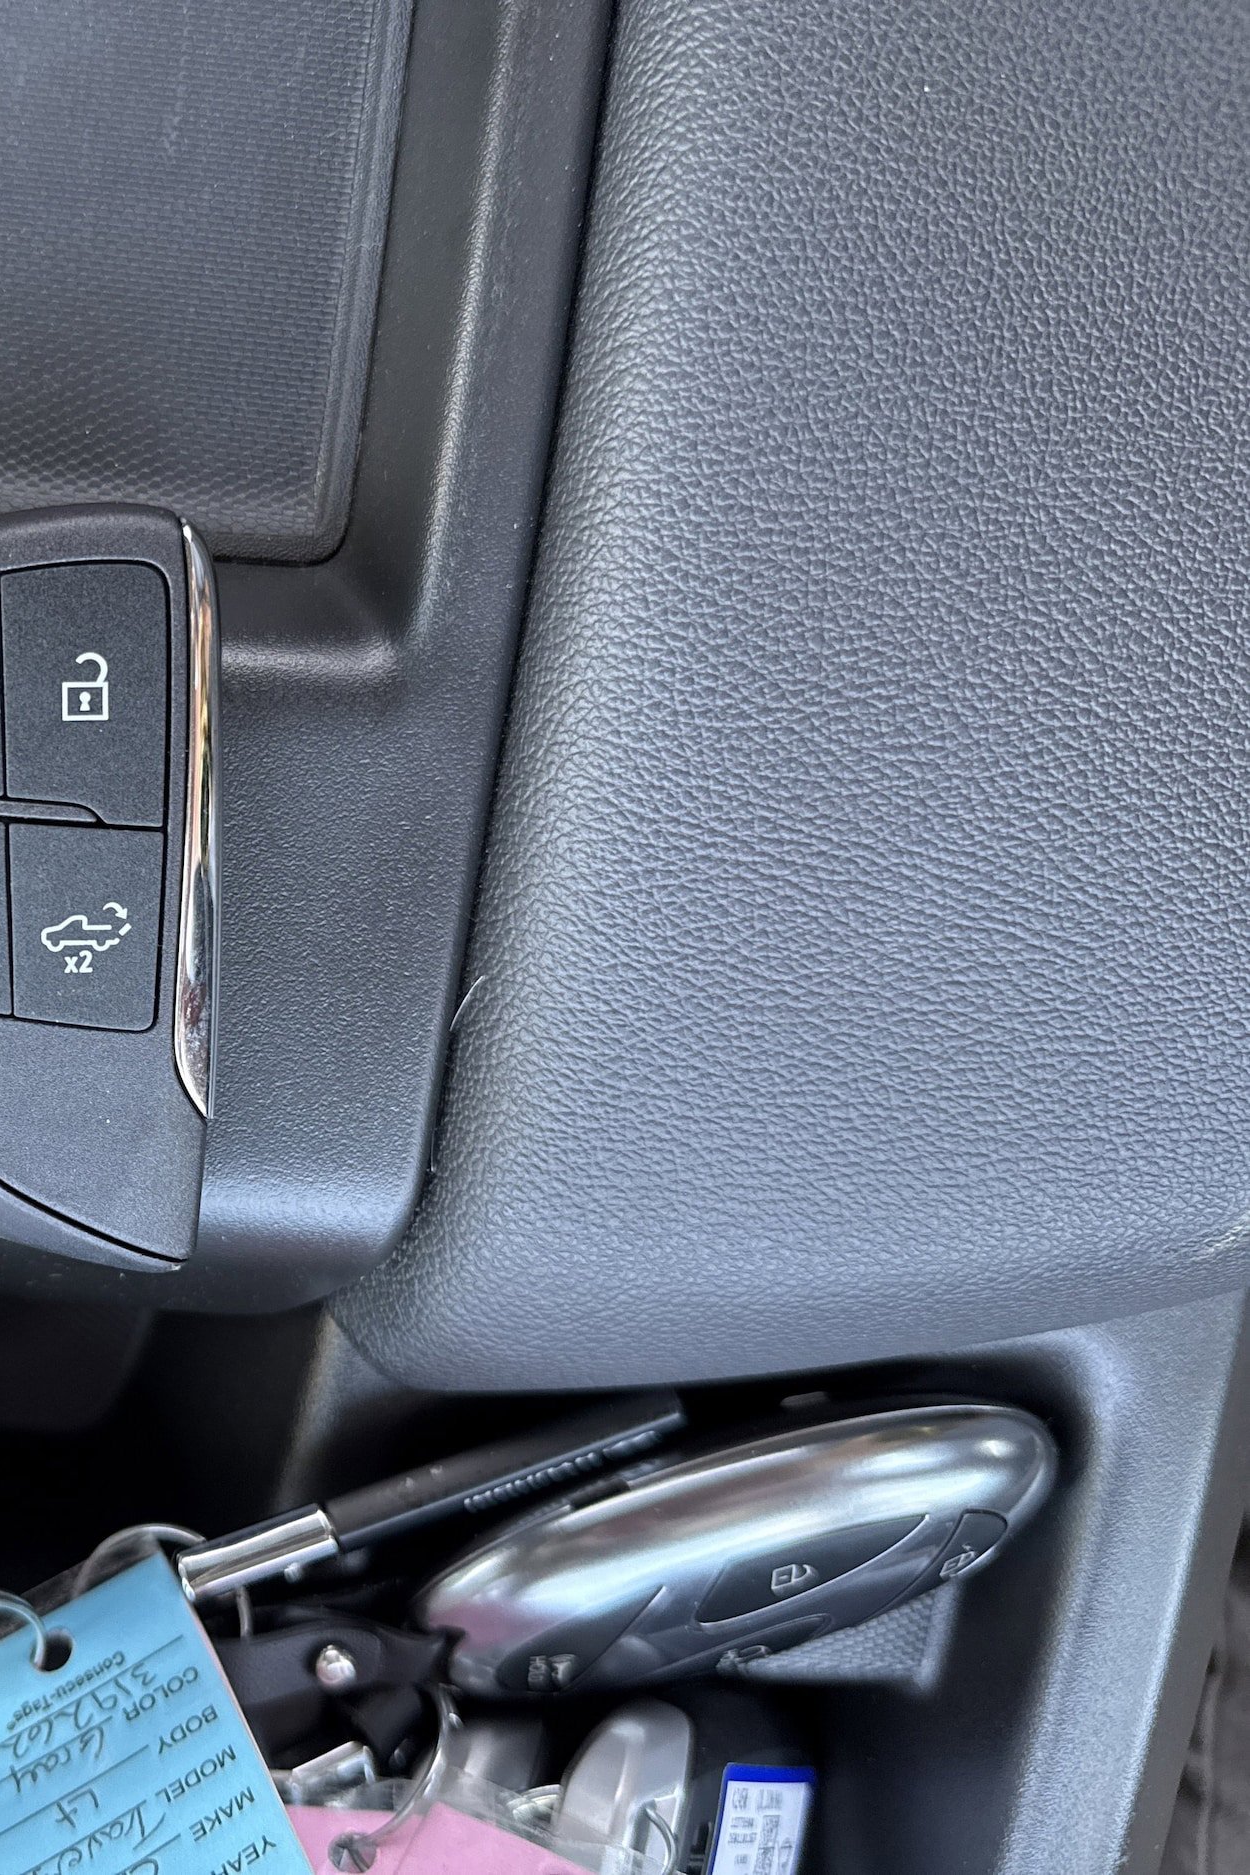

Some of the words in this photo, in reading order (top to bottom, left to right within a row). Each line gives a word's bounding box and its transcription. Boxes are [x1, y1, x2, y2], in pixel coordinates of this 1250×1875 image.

[64, 950, 93, 974] x2
[122, 1666, 199, 1722] COLOR
[158, 1704, 219, 1755] BODY
[155, 1744, 237, 1804] MODEL
[189, 1786, 256, 1842] MAKE
